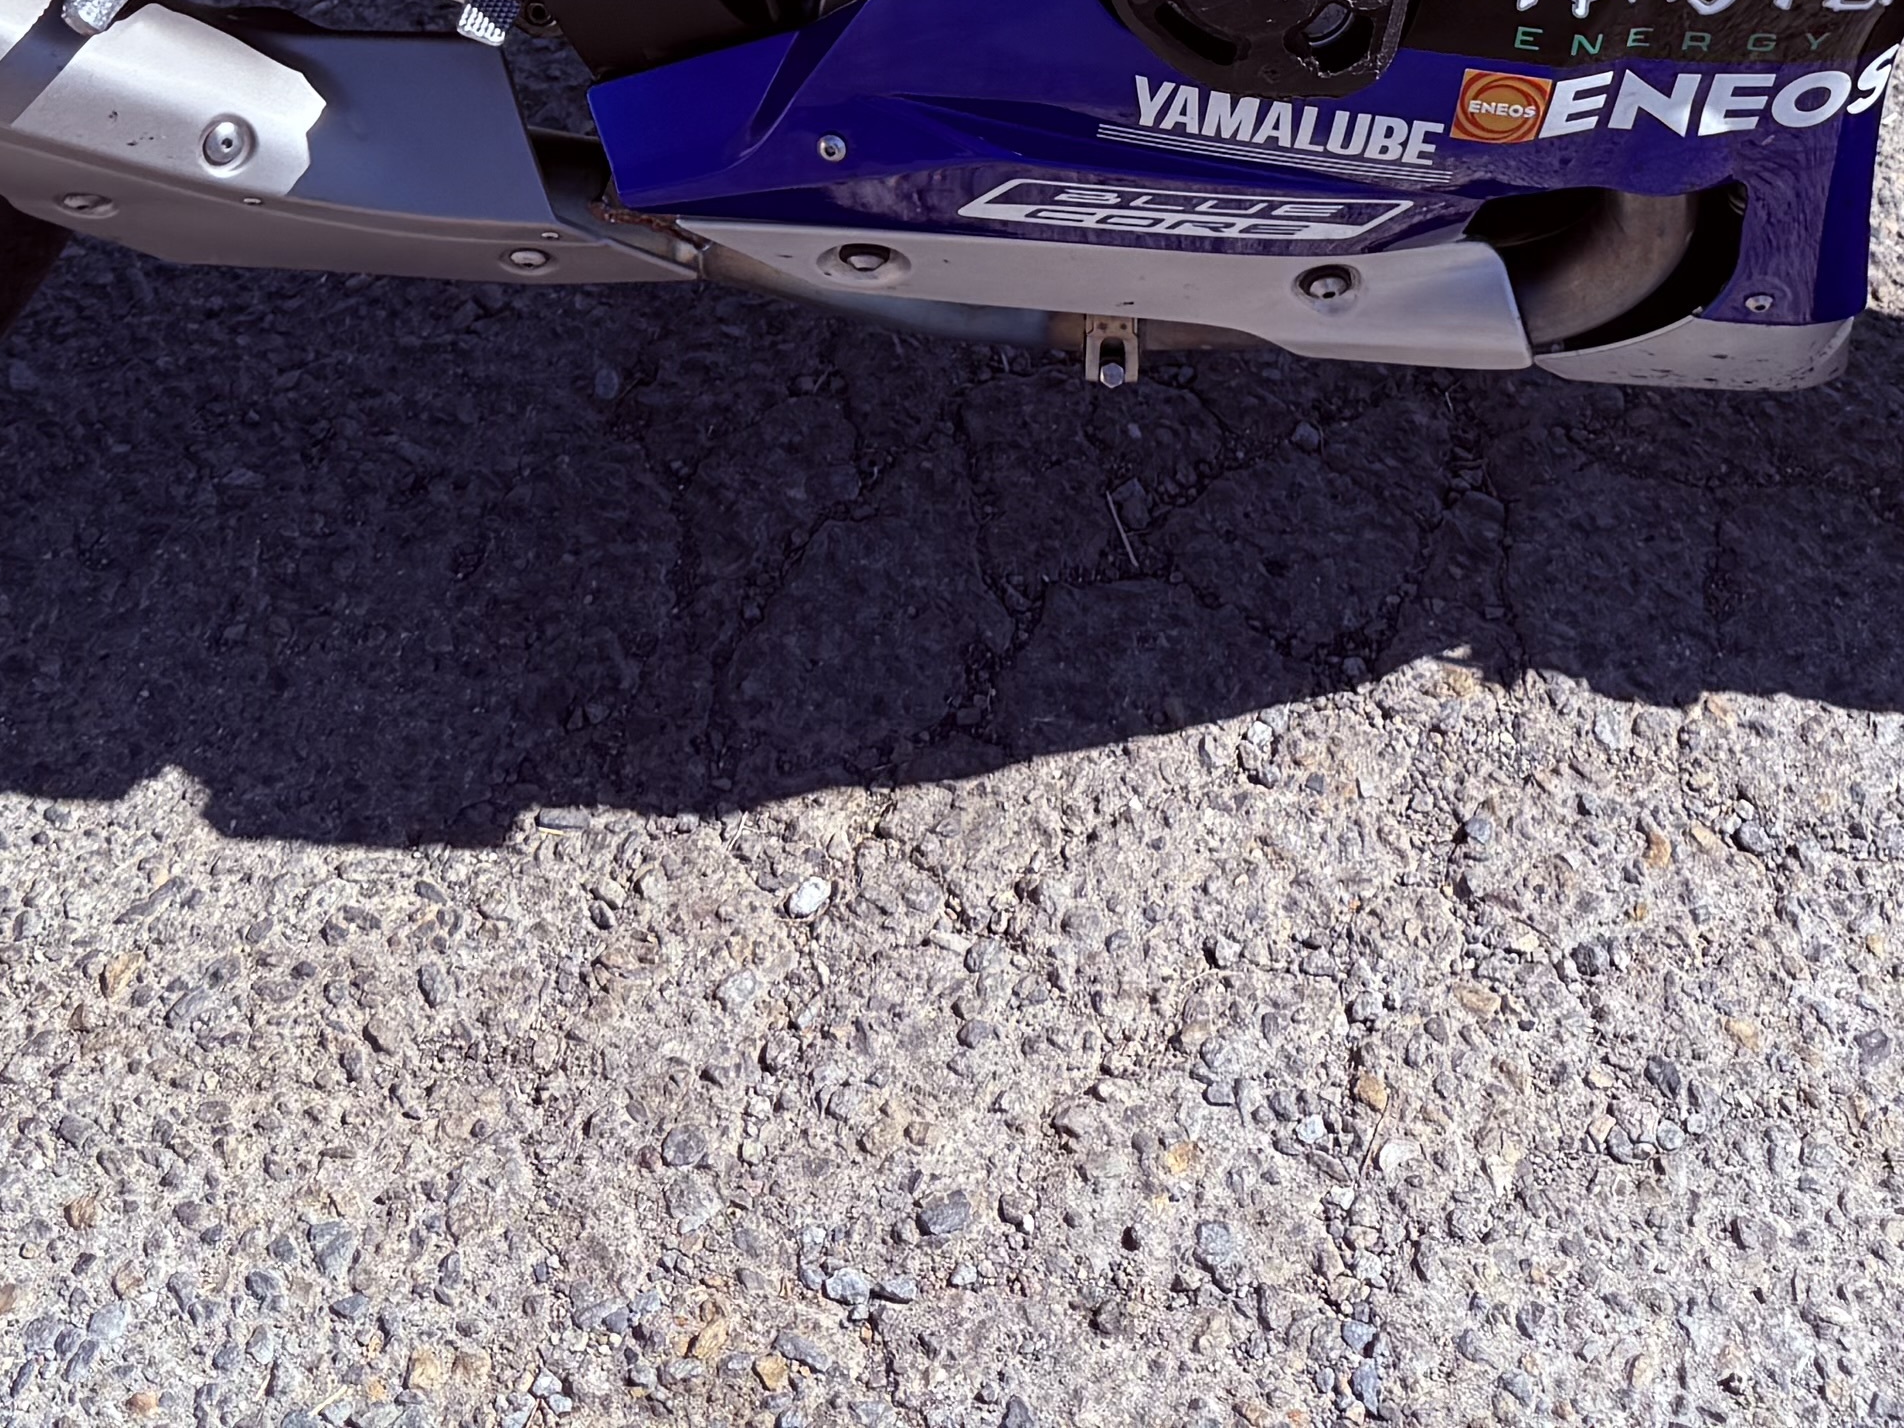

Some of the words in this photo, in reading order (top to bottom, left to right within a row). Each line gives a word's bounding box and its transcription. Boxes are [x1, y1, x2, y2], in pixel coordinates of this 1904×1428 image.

[1513, 25, 1832, 57] ENERGY
[1537, 42, 1901, 139] ENEOS
[1134, 74, 1446, 167] YAMALUBE
[1467, 98, 1538, 121] ENEOS
[1053, 188, 1346, 218] BLUE
[1023, 207, 1316, 236] CORE
